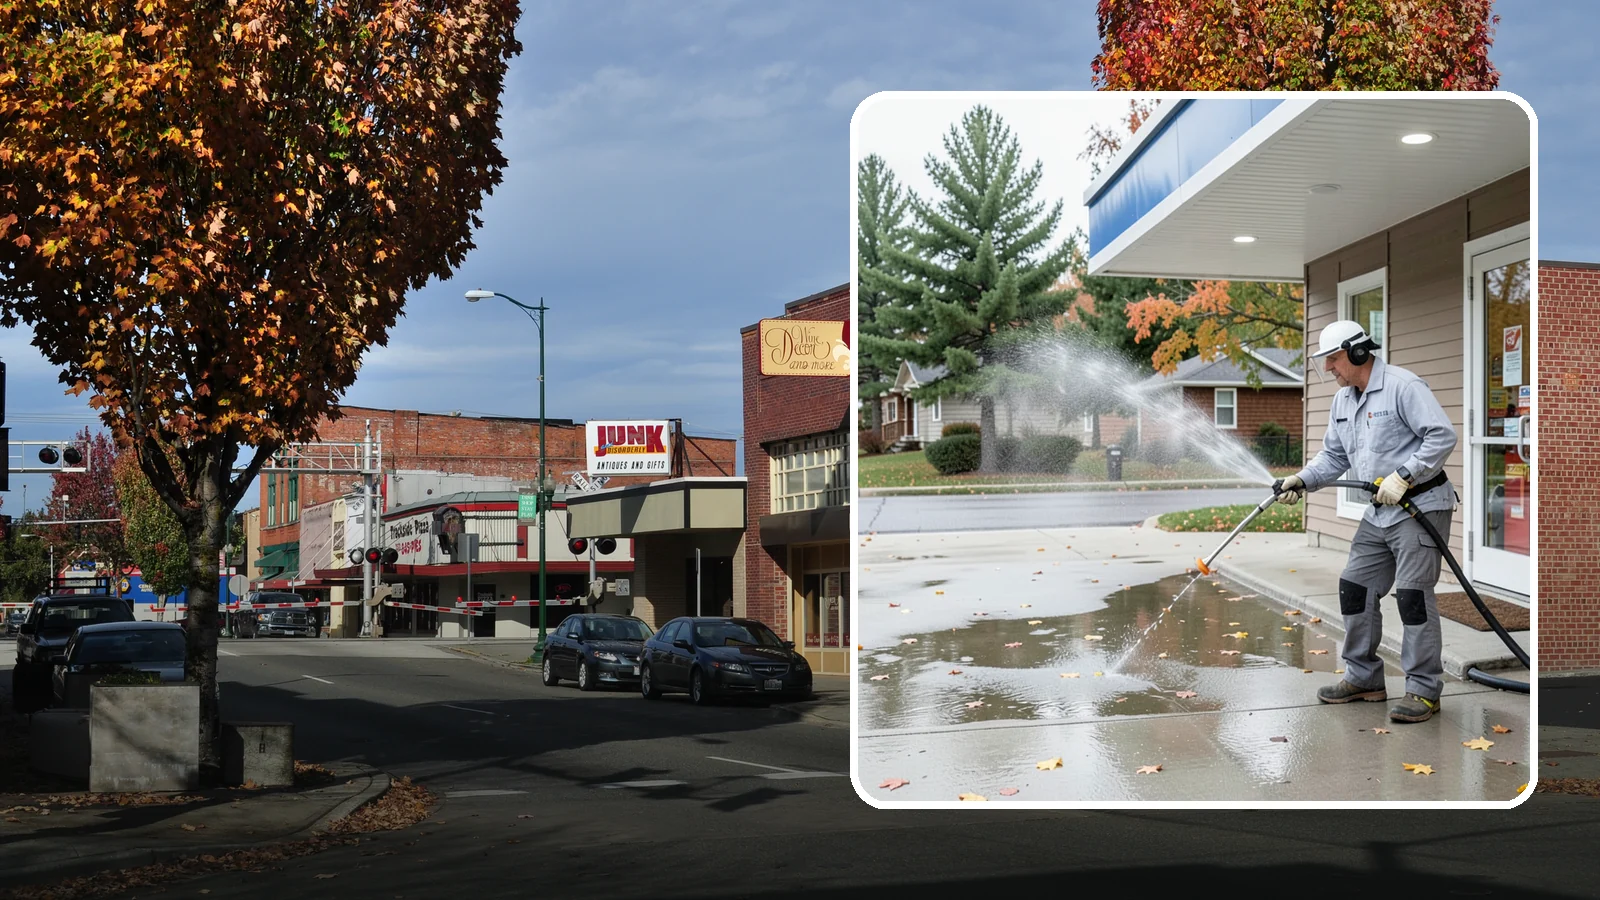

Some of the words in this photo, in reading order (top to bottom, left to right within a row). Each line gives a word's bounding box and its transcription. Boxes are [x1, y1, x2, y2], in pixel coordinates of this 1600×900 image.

[764, 327, 831, 366] Decor
[595, 425, 665, 457] JUNK
[607, 446, 646, 455] DISORDERLY
[596, 461, 628, 470] ANTIQUES
[630, 461, 644, 470] AND
[646, 460, 665, 469] GIFTS
[390, 521, 413, 540] Trackside
[414, 519, 429, 535] Pizza
